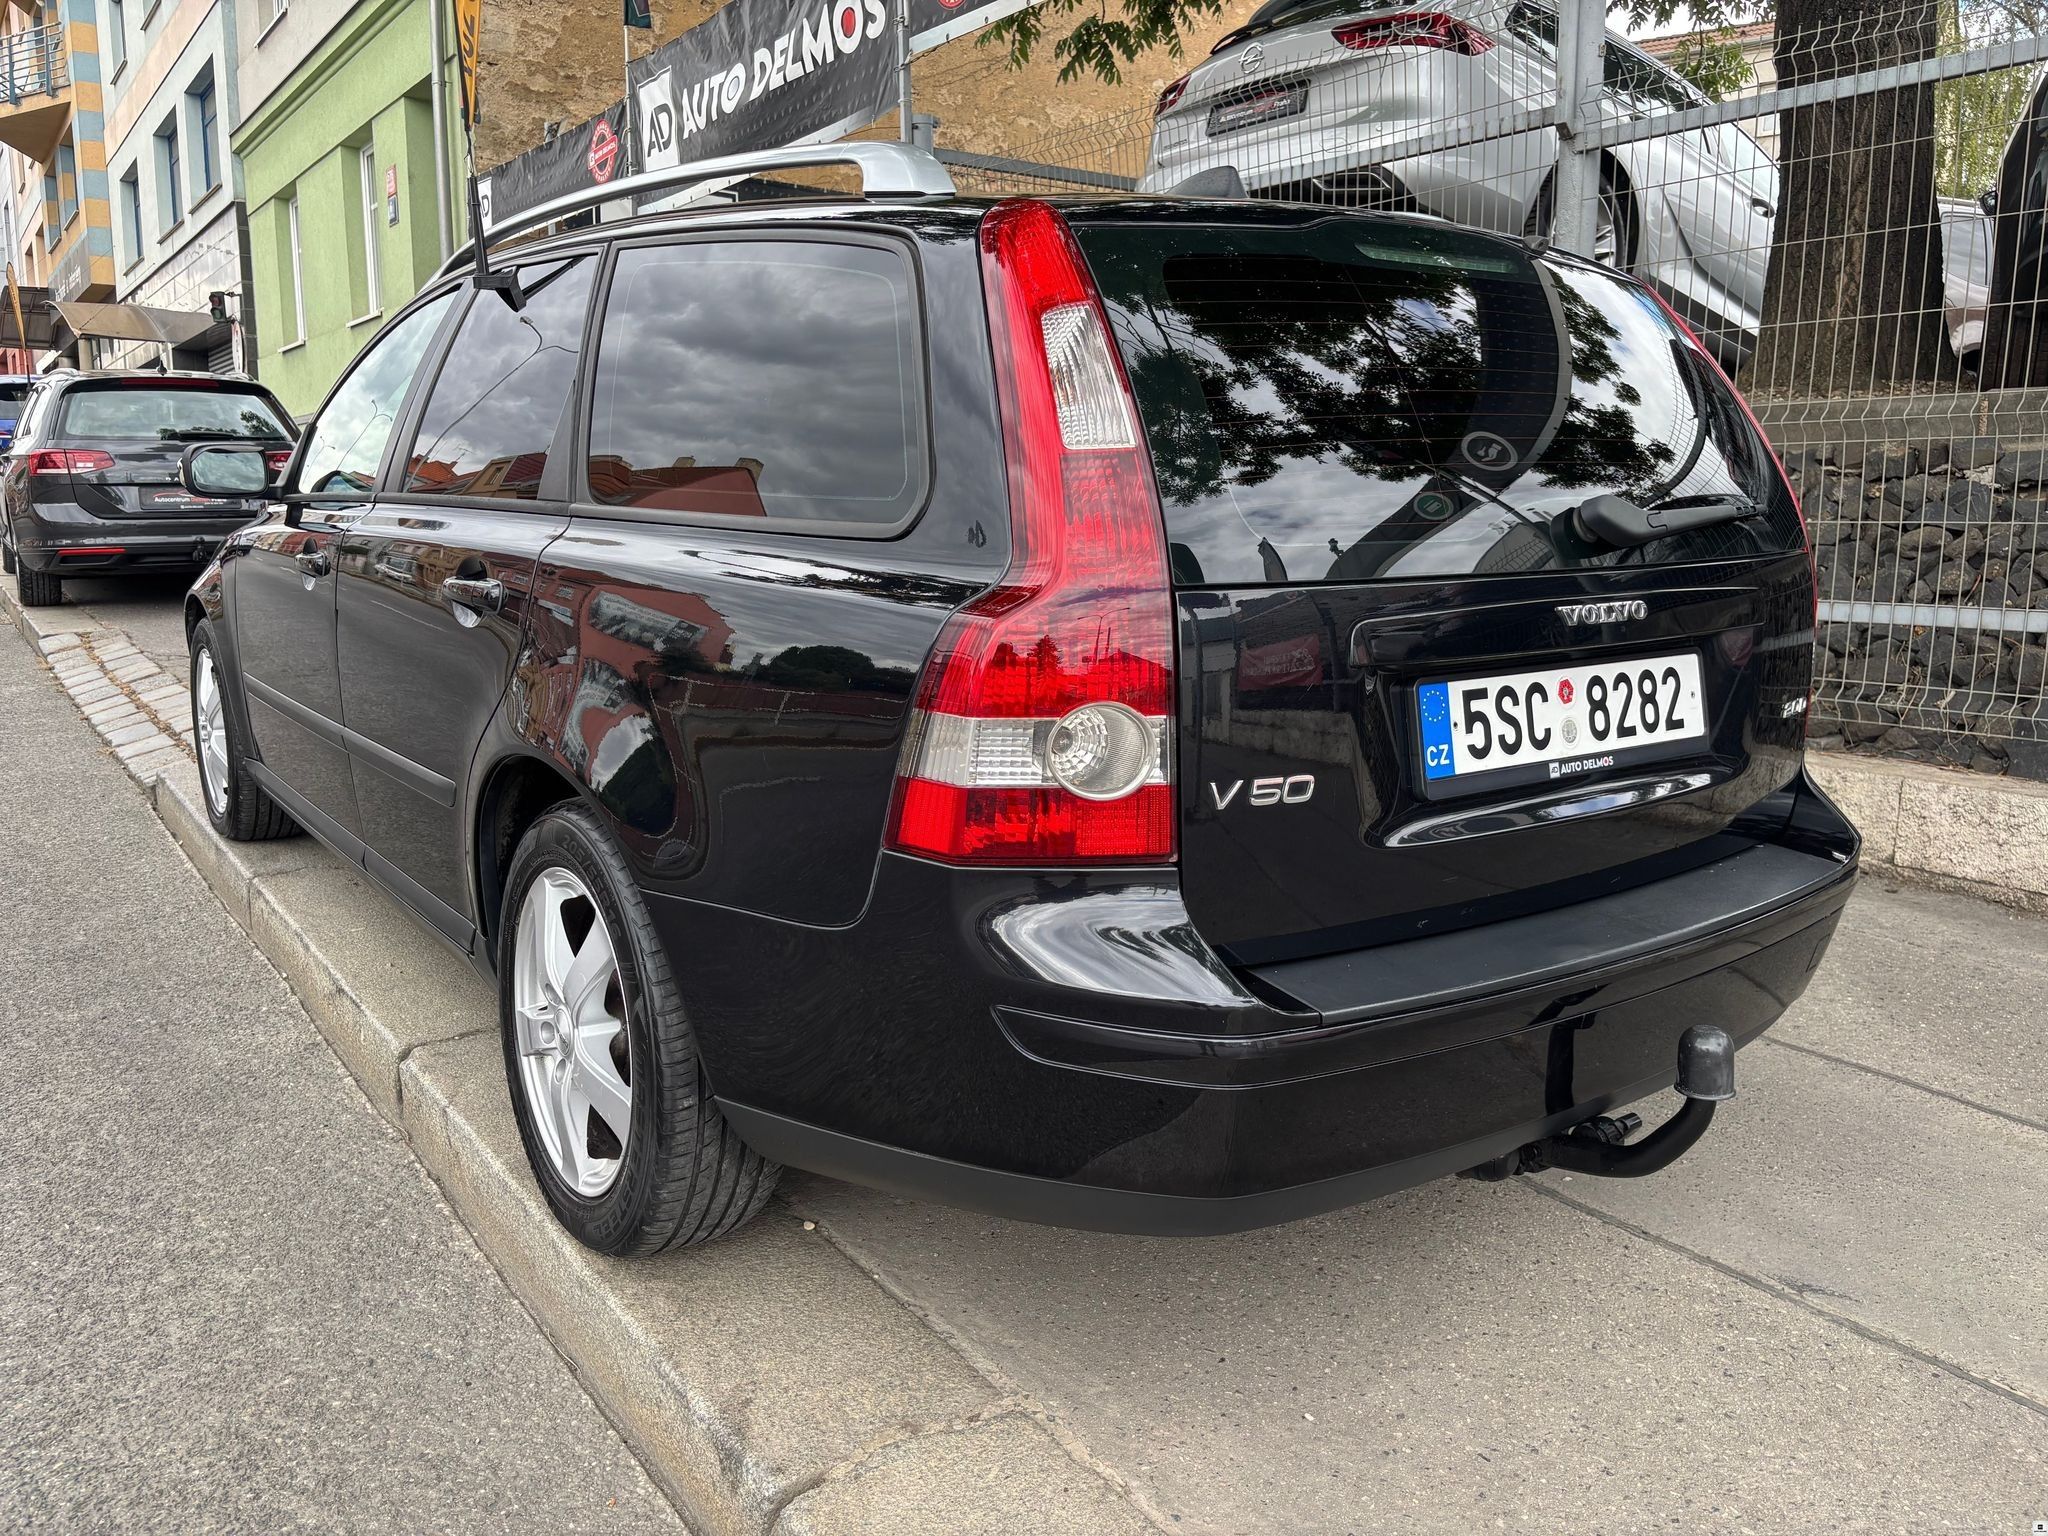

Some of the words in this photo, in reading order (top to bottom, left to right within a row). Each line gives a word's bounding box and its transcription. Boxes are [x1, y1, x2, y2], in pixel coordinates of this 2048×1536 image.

[681, 62, 746, 140] AUTO
[748, 0, 886, 102] DELMOS
[1556, 600, 1648, 627] VOLVO
[1462, 682, 1551, 760] 5SC
[1587, 667, 1685, 741] 8282
[1427, 743, 1450, 767] CZ
[1560, 761, 1582, 774] AUTO
[1583, 756, 1614, 770] DELMOS
